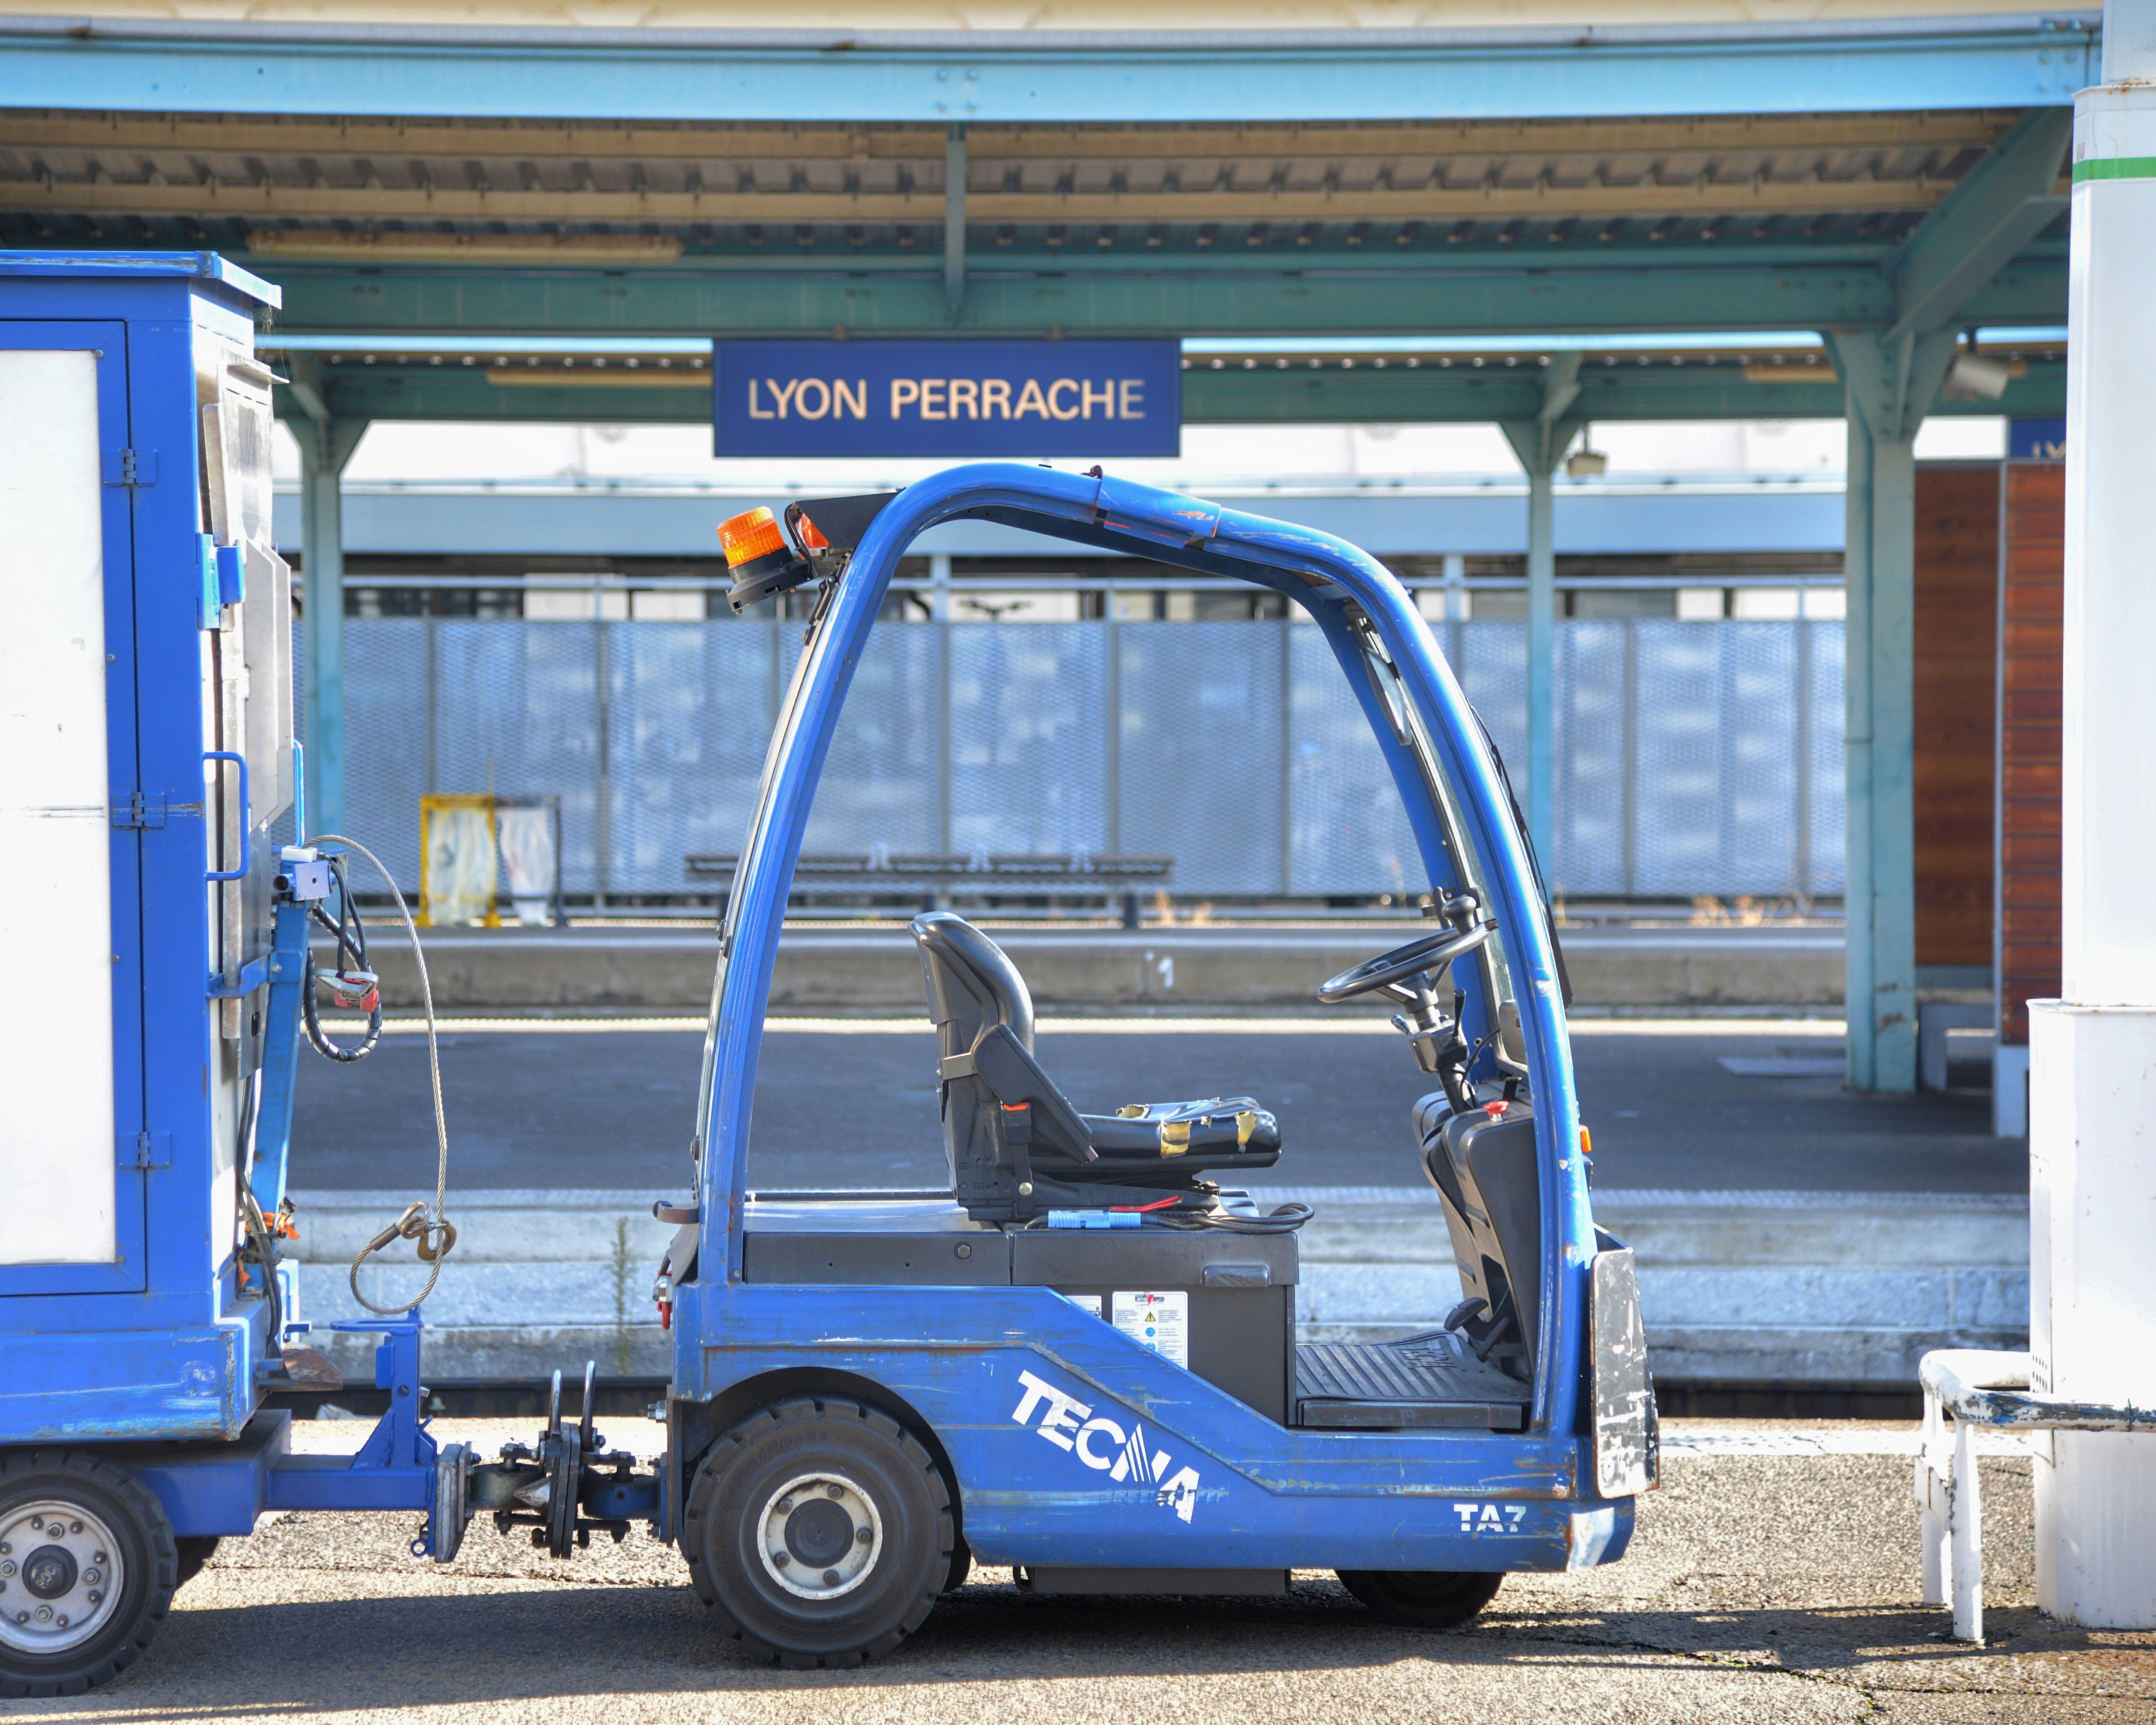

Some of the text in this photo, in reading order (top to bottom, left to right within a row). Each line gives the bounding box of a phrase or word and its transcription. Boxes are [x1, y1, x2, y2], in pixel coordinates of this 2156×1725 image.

[749, 377, 1146, 421] LYON PERRACHE
[1012, 1370, 1200, 1524] TECNA
[1453, 1504, 1526, 1532] TA7
